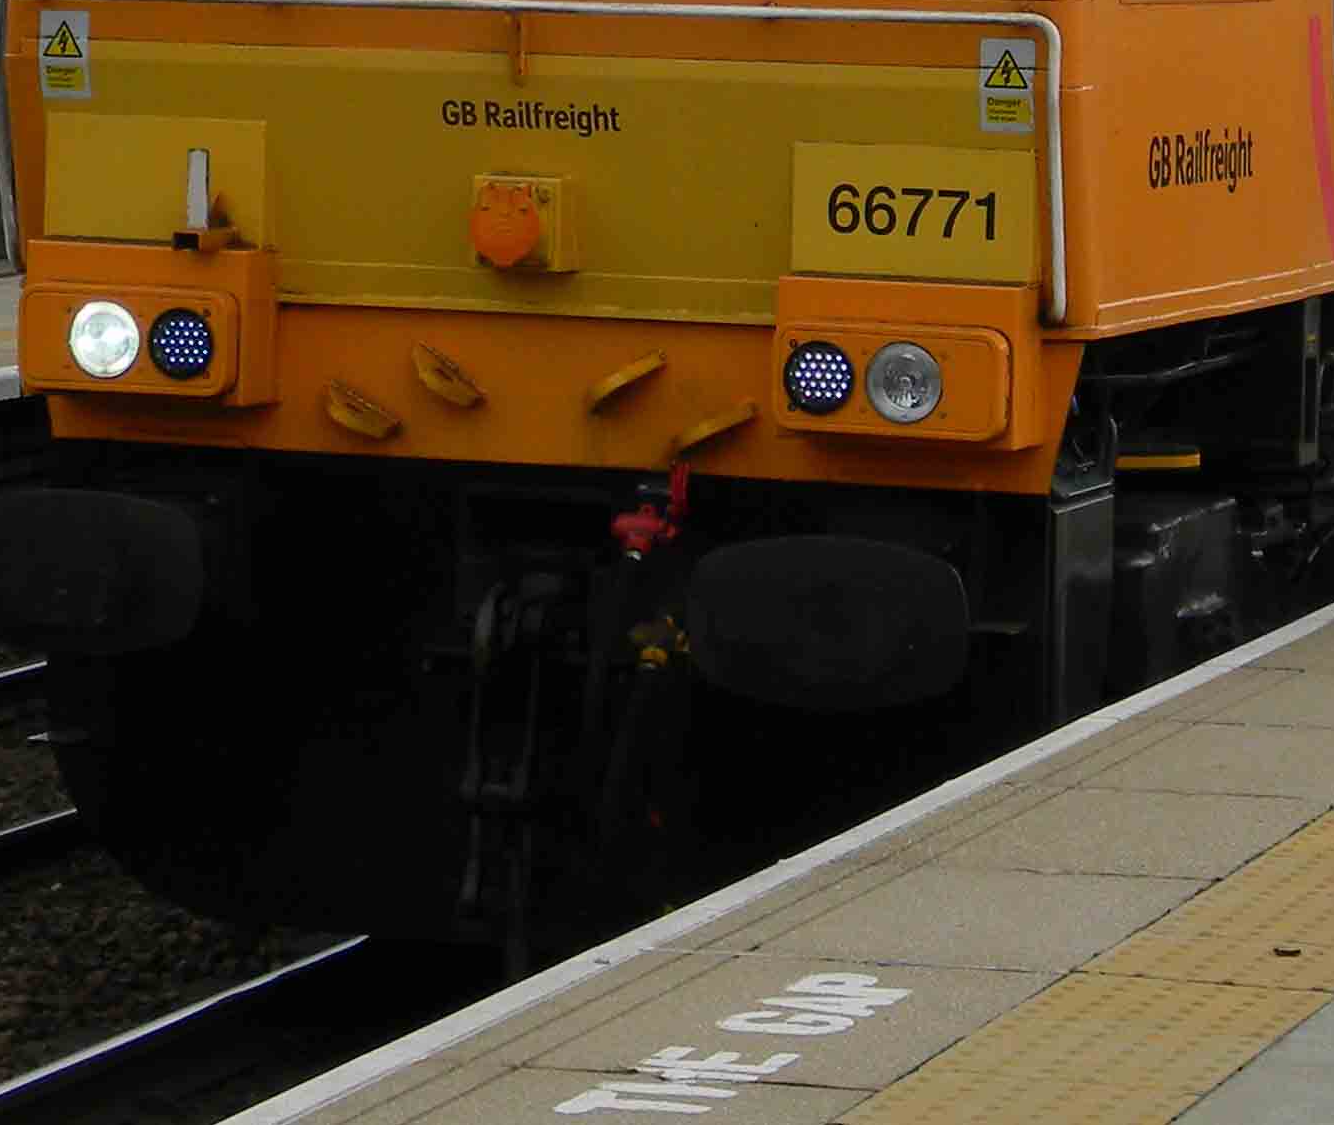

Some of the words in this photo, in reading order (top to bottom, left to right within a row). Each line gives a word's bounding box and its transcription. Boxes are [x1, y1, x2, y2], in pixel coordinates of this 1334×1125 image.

[442, 100, 478, 127] GB
[484, 100, 621, 138] Railfreight
[1149, 135, 1171, 189] GB
[1175, 126, 1253, 194] Railfreight
[827, 183, 996, 241] 66771
[553, 1045, 802, 1115] THE
[717, 971, 913, 1036] GAP
